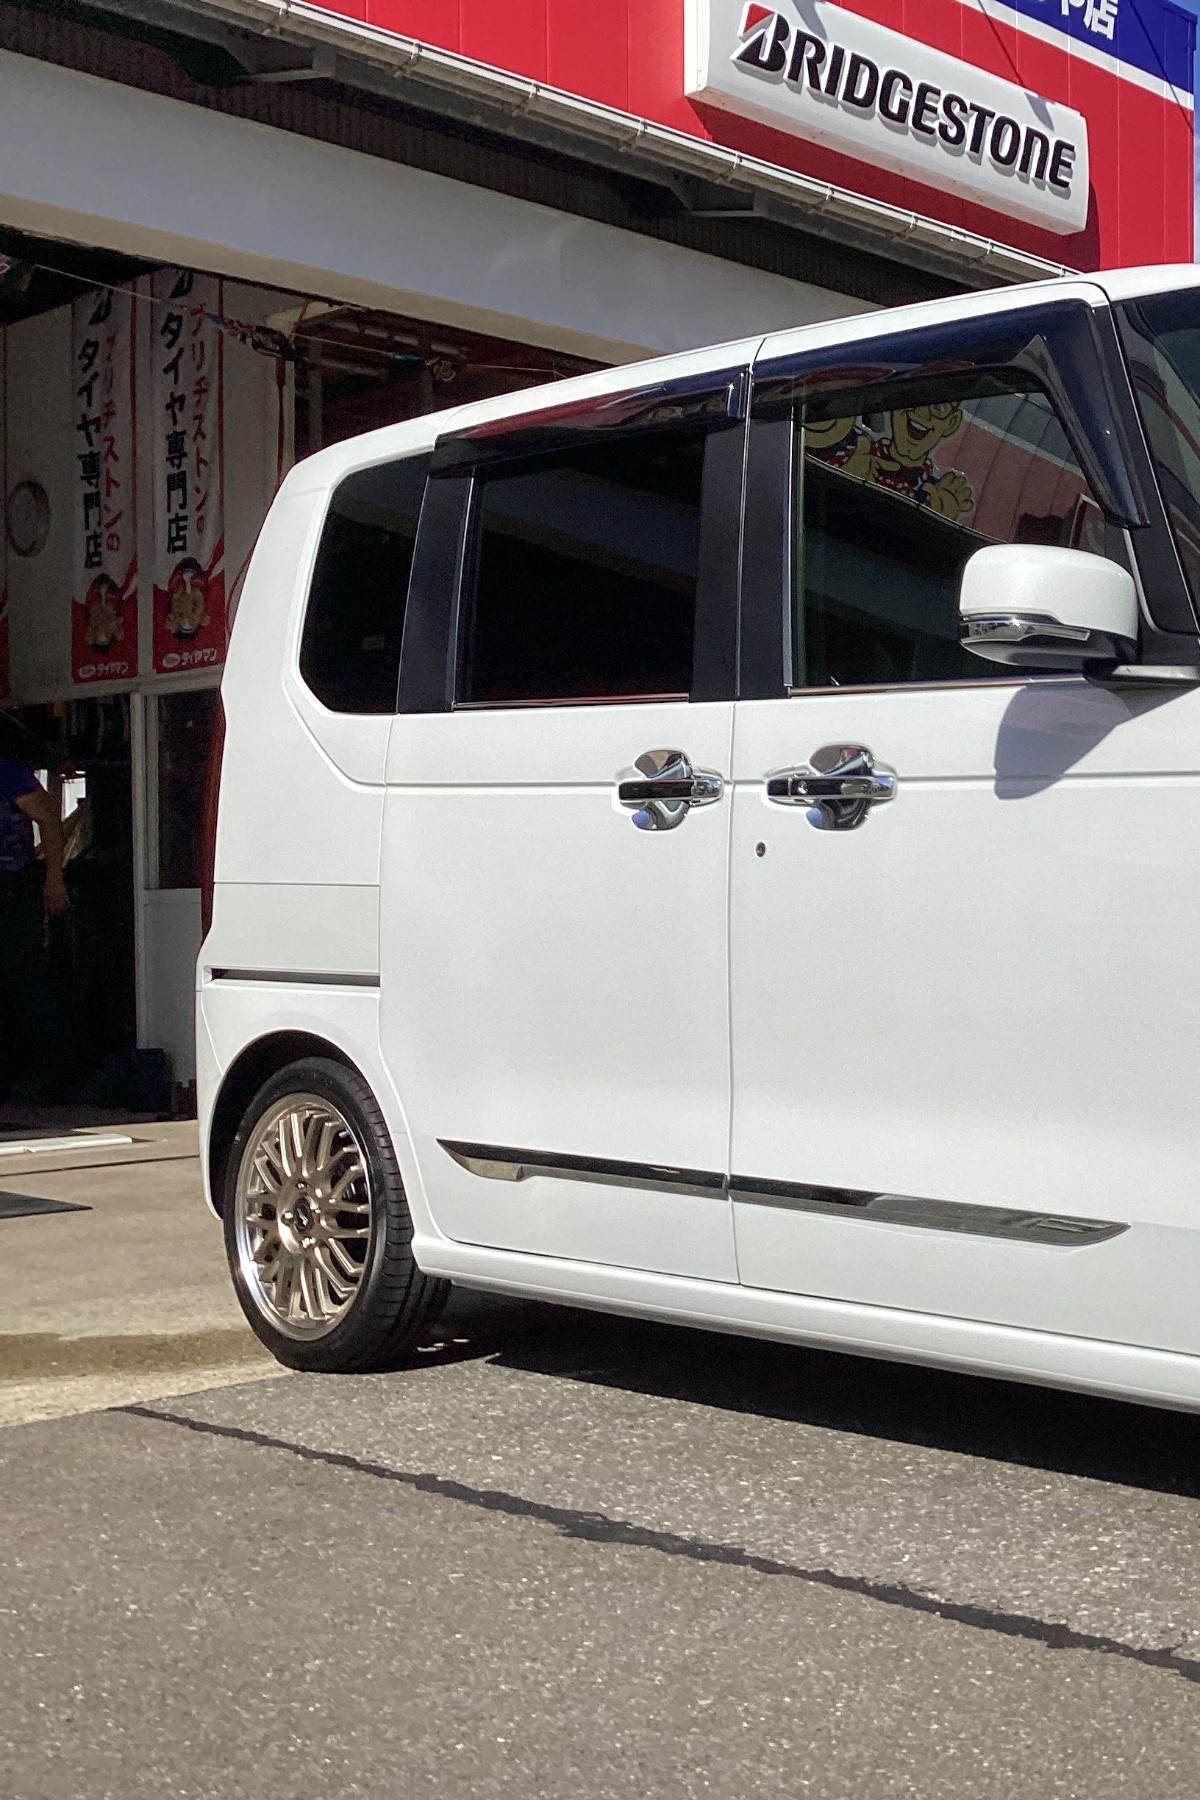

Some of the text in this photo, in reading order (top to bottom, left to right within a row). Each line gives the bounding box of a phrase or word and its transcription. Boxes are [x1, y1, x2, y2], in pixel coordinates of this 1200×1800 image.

[733, 4, 1077, 190] BRIDGESTONE
[76, 338, 102, 569] タイヤ専門店
[160, 312, 188, 554] タイヤ専門店
